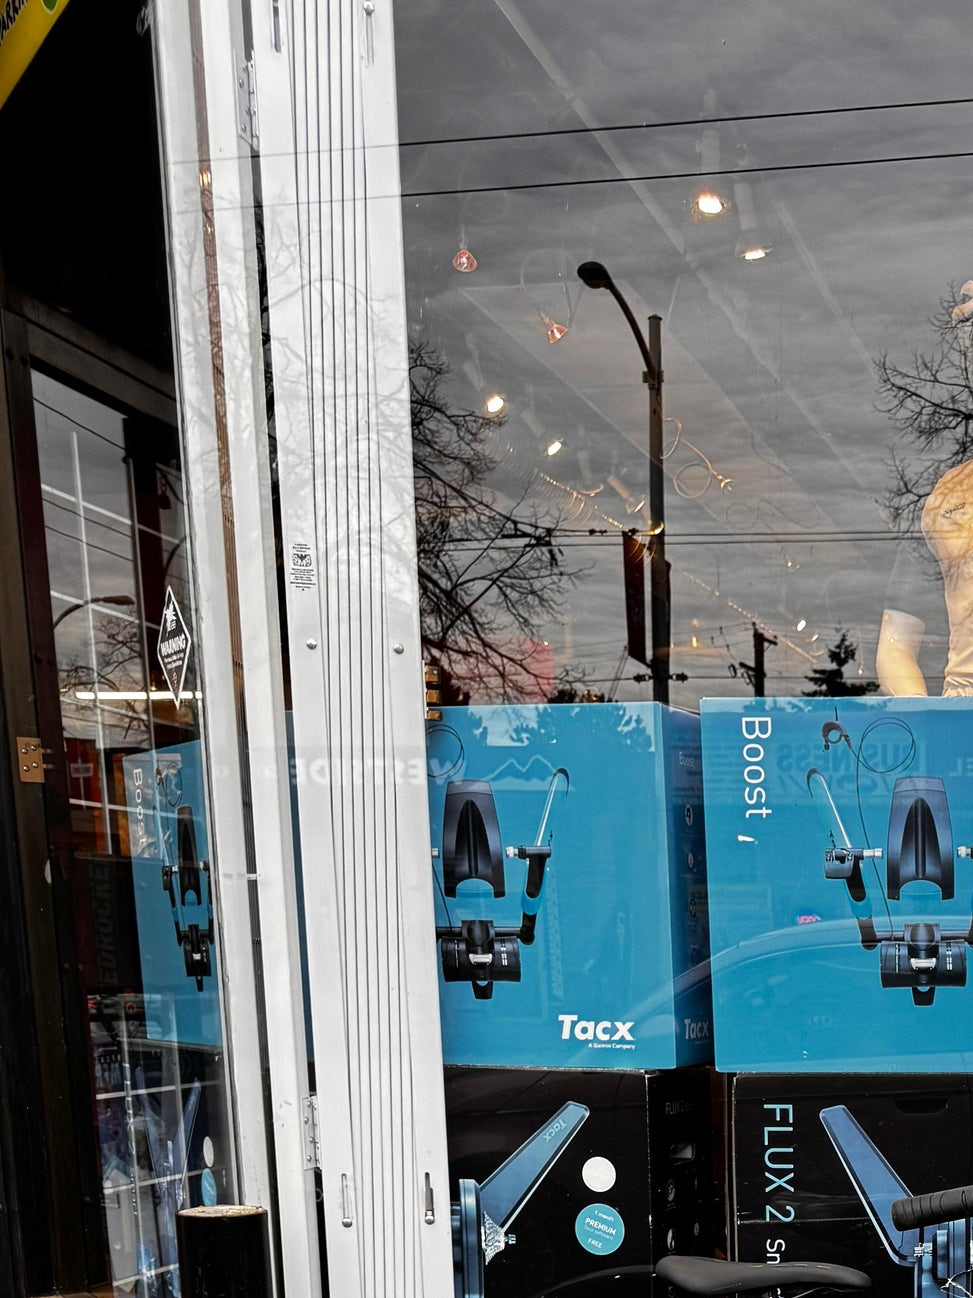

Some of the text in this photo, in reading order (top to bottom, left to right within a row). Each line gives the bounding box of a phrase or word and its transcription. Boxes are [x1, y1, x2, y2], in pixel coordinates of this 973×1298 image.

[741, 716, 773, 819] Boost
[558, 1014, 636, 1041] Tacx
[684, 1018, 709, 1040] Tacx
[543, 1118, 567, 1143] Tacx
[763, 1103, 795, 1193] FLUX
[765, 1204, 795, 1223] 2
[584, 1217, 617, 1237] PREMIUM
[587, 1237, 603, 1249] FREE
